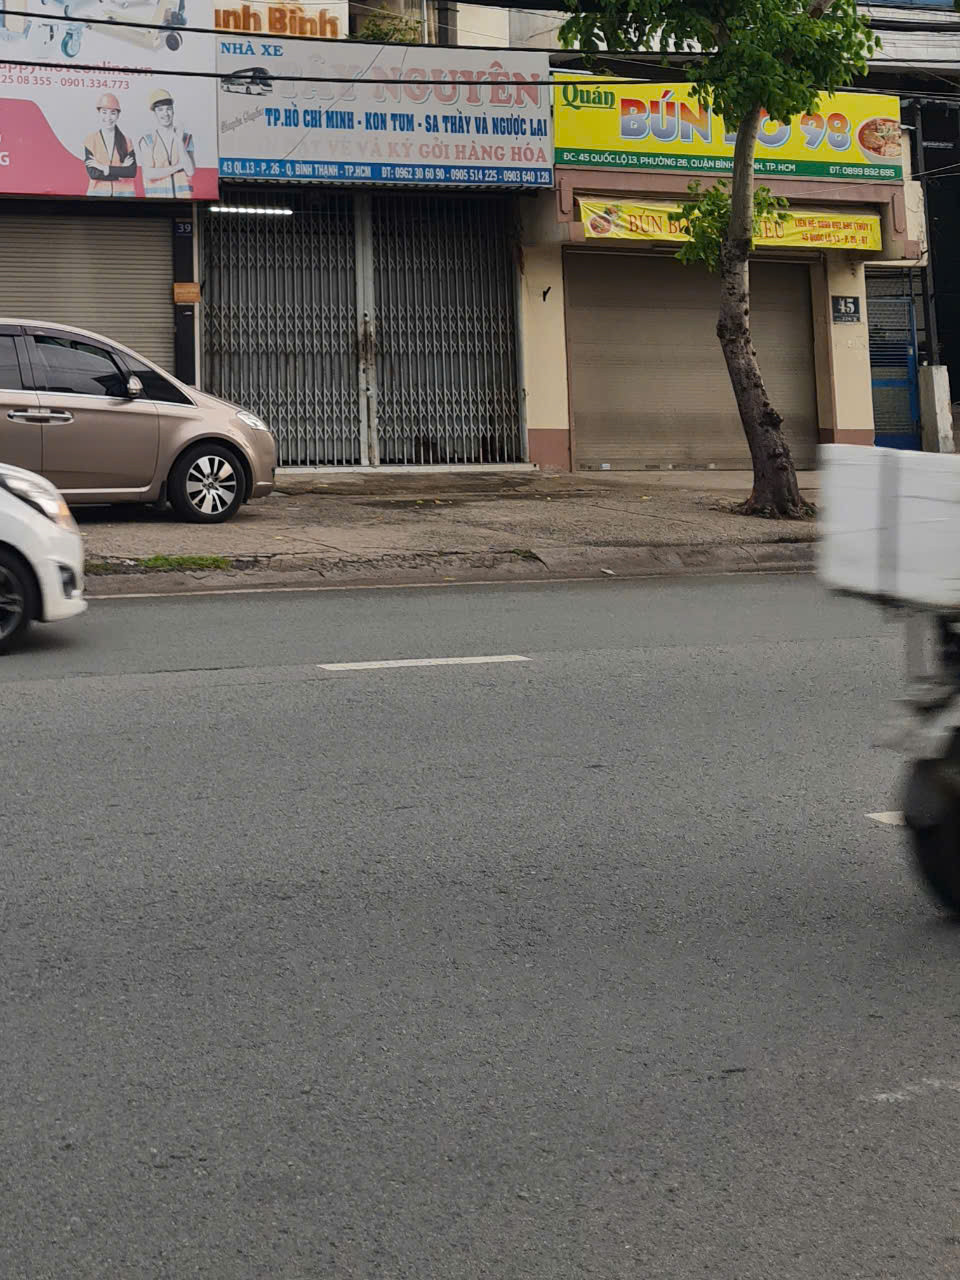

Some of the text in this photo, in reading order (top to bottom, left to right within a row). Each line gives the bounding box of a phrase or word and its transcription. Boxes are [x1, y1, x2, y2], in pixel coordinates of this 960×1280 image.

[214, 3, 340, 38] nh Bình
[220, 40, 284, 57] NHÀ XE
[16, 75, 30, 85] 08
[32, 75, 52, 86] 355
[60, 77, 130, 90] 0901.334.773
[372, 60, 542, 108] NGUYÊN
[561, 83, 616, 110] Quán
[264, 101, 299, 128] TP.HỒ
[303, 105, 323, 129] CHÍ
[326, 110, 355, 130] MINH
[365, 111, 388, 131] KON
[390, 113, 415, 132] TUM
[425, 114, 440, 133] SA
[474, 112, 489, 135] VÀ
[492, 113, 527, 141] NGƯỢC
[530, 118, 548, 141] LẠI
[620, 89, 713, 144] BÚN
[800, 112, 852, 152] 98
[455, 140, 506, 162] HÀNG
[510, 142, 548, 163] HÓA
[578, 153, 590, 161] 45
[591, 151, 616, 163] QUỐC
[640, 155, 676, 167] PHƯỜNG
[691, 158, 715, 170] QUẬN
[715, 159, 735, 169] BÌNH
[222, 162, 233, 173] 43
[270, 163, 280, 174] 26
[295, 161, 313, 176] BÌNH
[314, 164, 339, 178] THẠNH
[344, 164, 371, 177] TP.HCM
[381, 166, 394, 178] ĐT:
[395, 167, 413, 179] 0962
[414, 167, 424, 179] 30
[425, 168, 434, 179] 60
[436, 168, 445, 180] 90
[451, 169, 468, 180] 0905
[469, 169, 483, 181] 514
[484, 170, 497, 181] 225
[503, 170, 521, 182] 0903
[522, 171, 535, 182] 640
[537, 171, 550, 183] 128
[778, 164, 796, 172] HCM
[177, 224, 191, 233] 39
[628, 208, 663, 233] BÚN
[838, 298, 855, 314] 45
